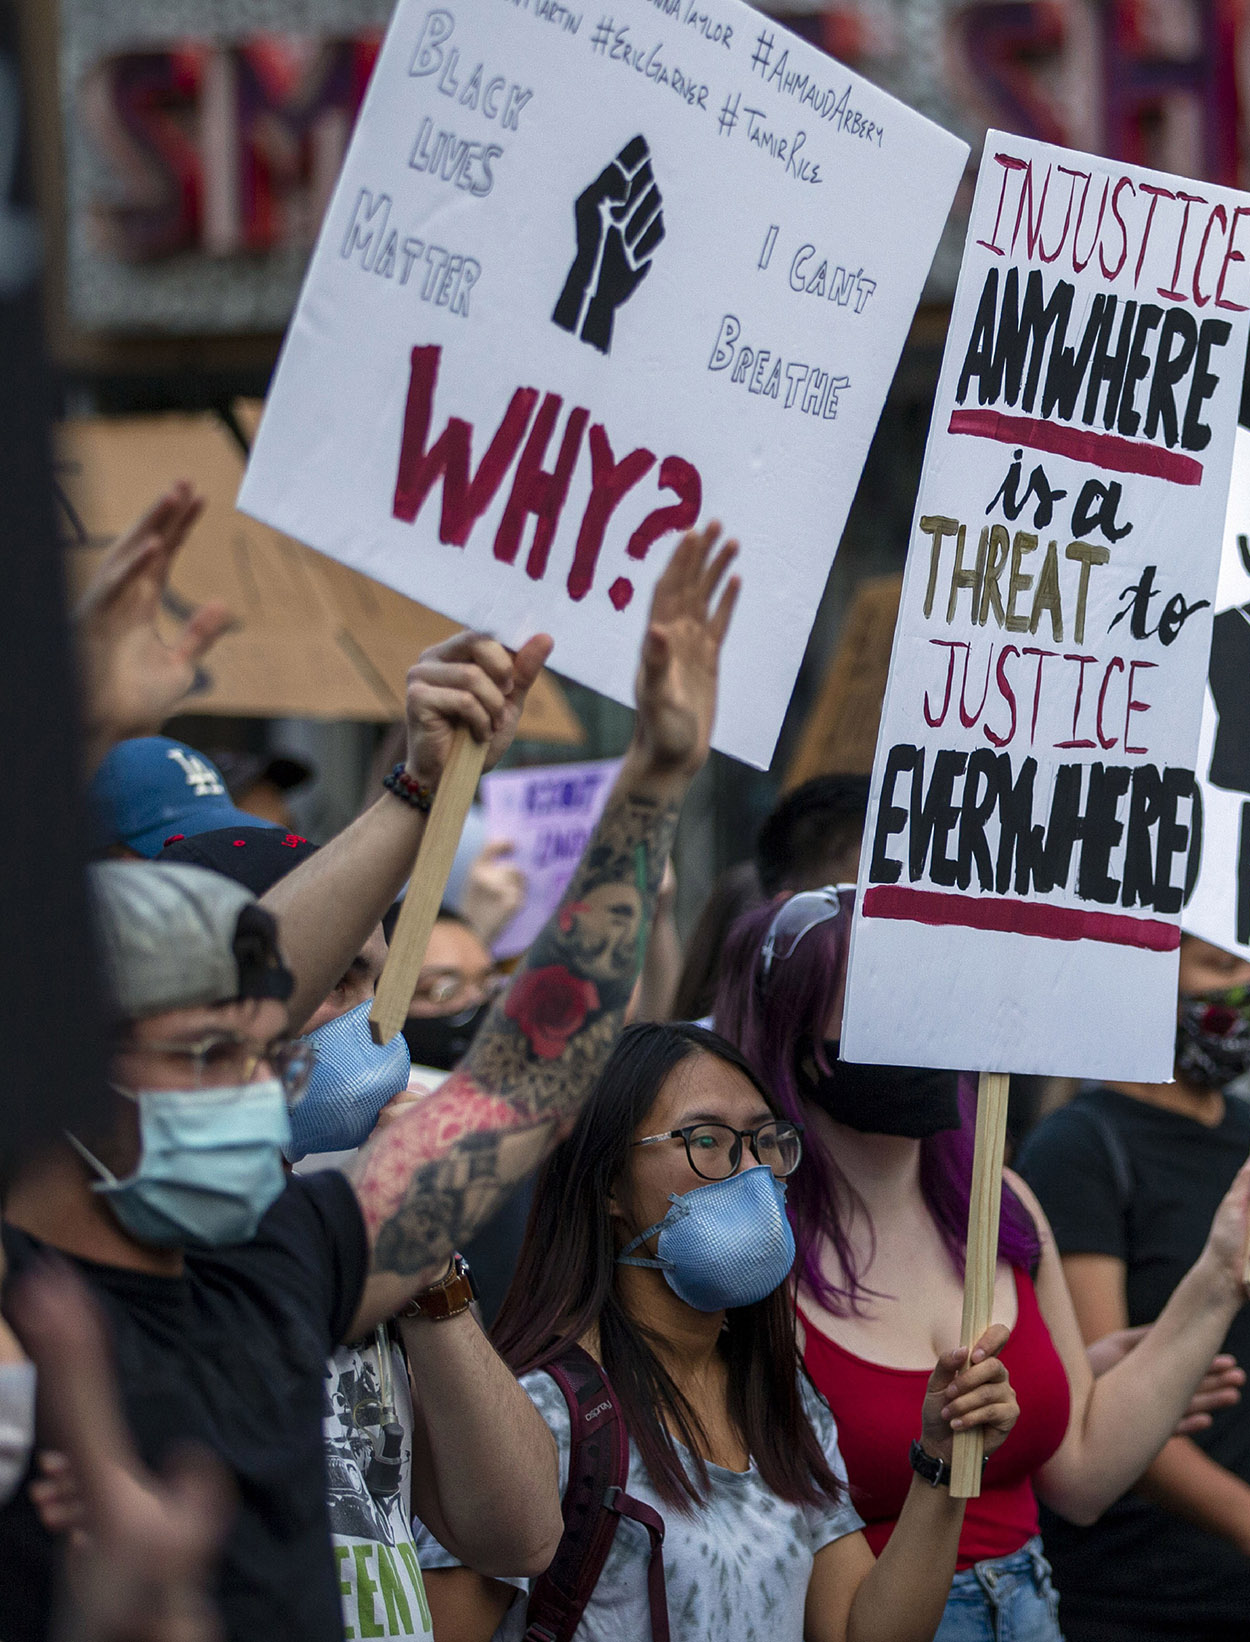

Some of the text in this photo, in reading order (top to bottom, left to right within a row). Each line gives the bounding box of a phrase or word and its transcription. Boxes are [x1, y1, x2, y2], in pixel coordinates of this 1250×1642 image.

[409, 9, 534, 131] BLACK
[408, 116, 505, 198] LIVES
[341, 187, 482, 318] MATTER
[758, 224, 877, 314] I CAN'T
[708, 314, 851, 420] BREATHE
[955, 266, 1232, 451] ANYWHERE
[391, 344, 703, 612] WHY?
[985, 449, 1133, 543] is a
[920, 515, 1211, 646] THREAT to
[924, 638, 1159, 754] JUSTICE
[869, 744, 1197, 914] EVERYWHERE
